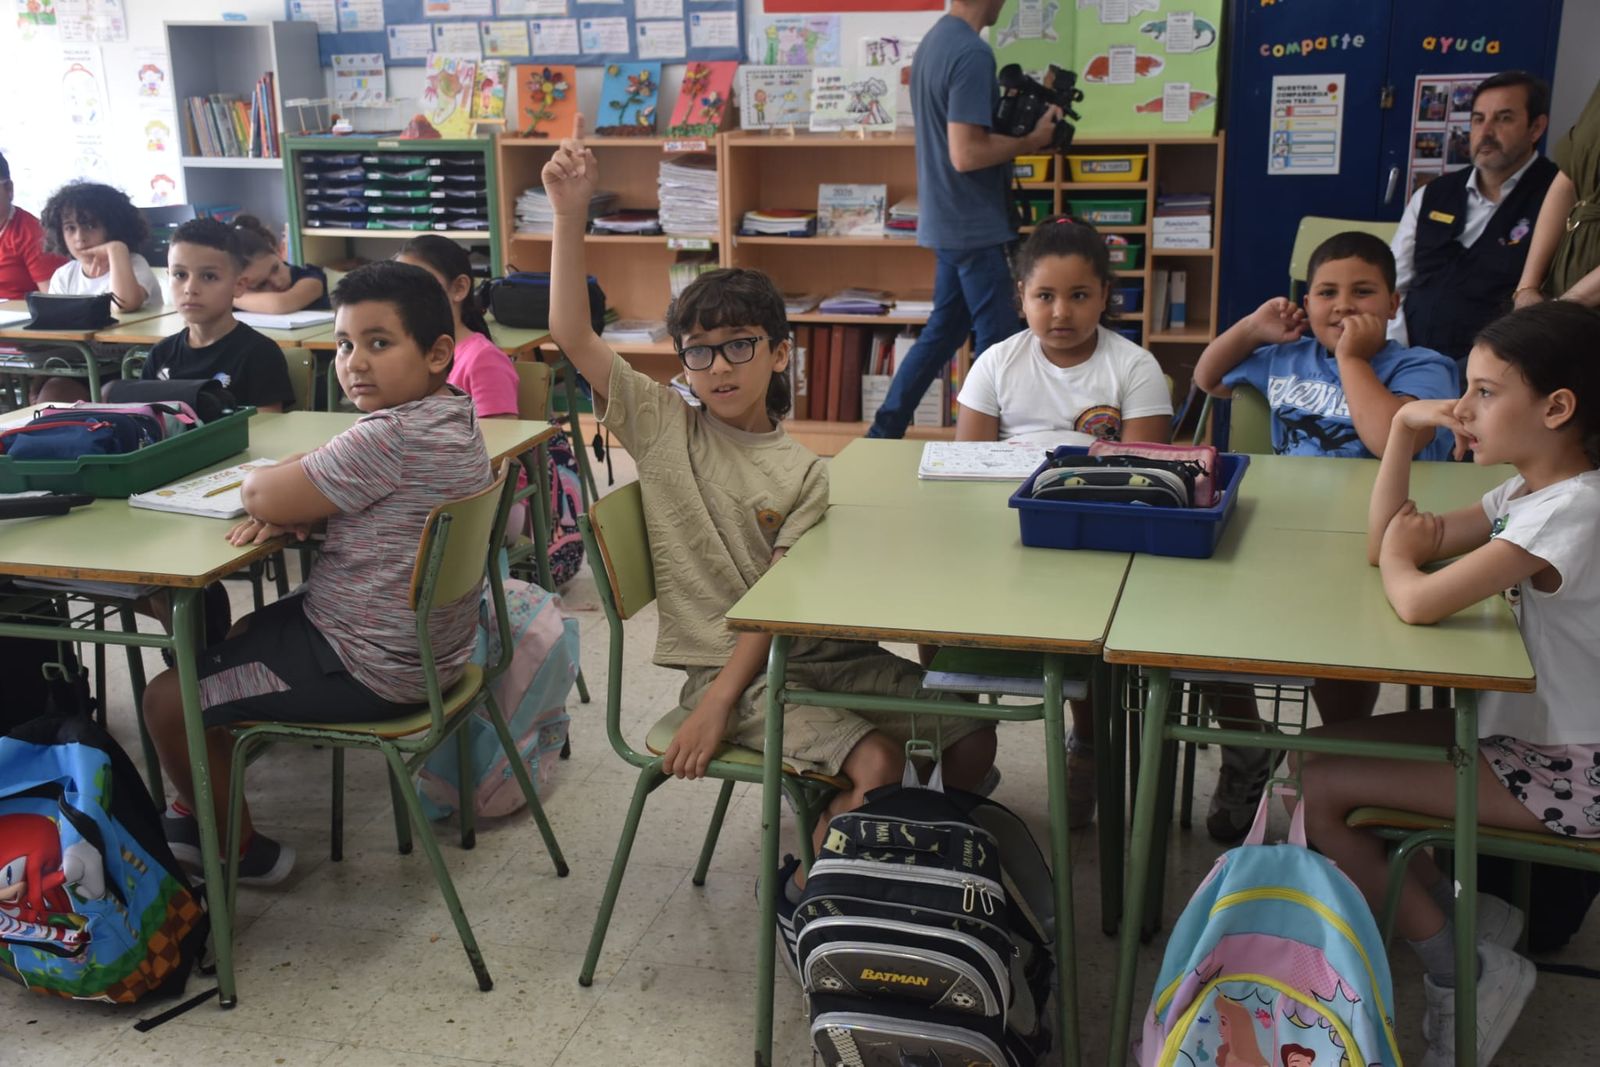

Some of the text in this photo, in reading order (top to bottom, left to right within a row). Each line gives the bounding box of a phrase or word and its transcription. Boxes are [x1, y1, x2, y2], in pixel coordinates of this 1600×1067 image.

[1260, 33, 1365, 57] comparte
[1423, 36, 1500, 54] ayuda
[861, 968, 928, 986] BATMAN
